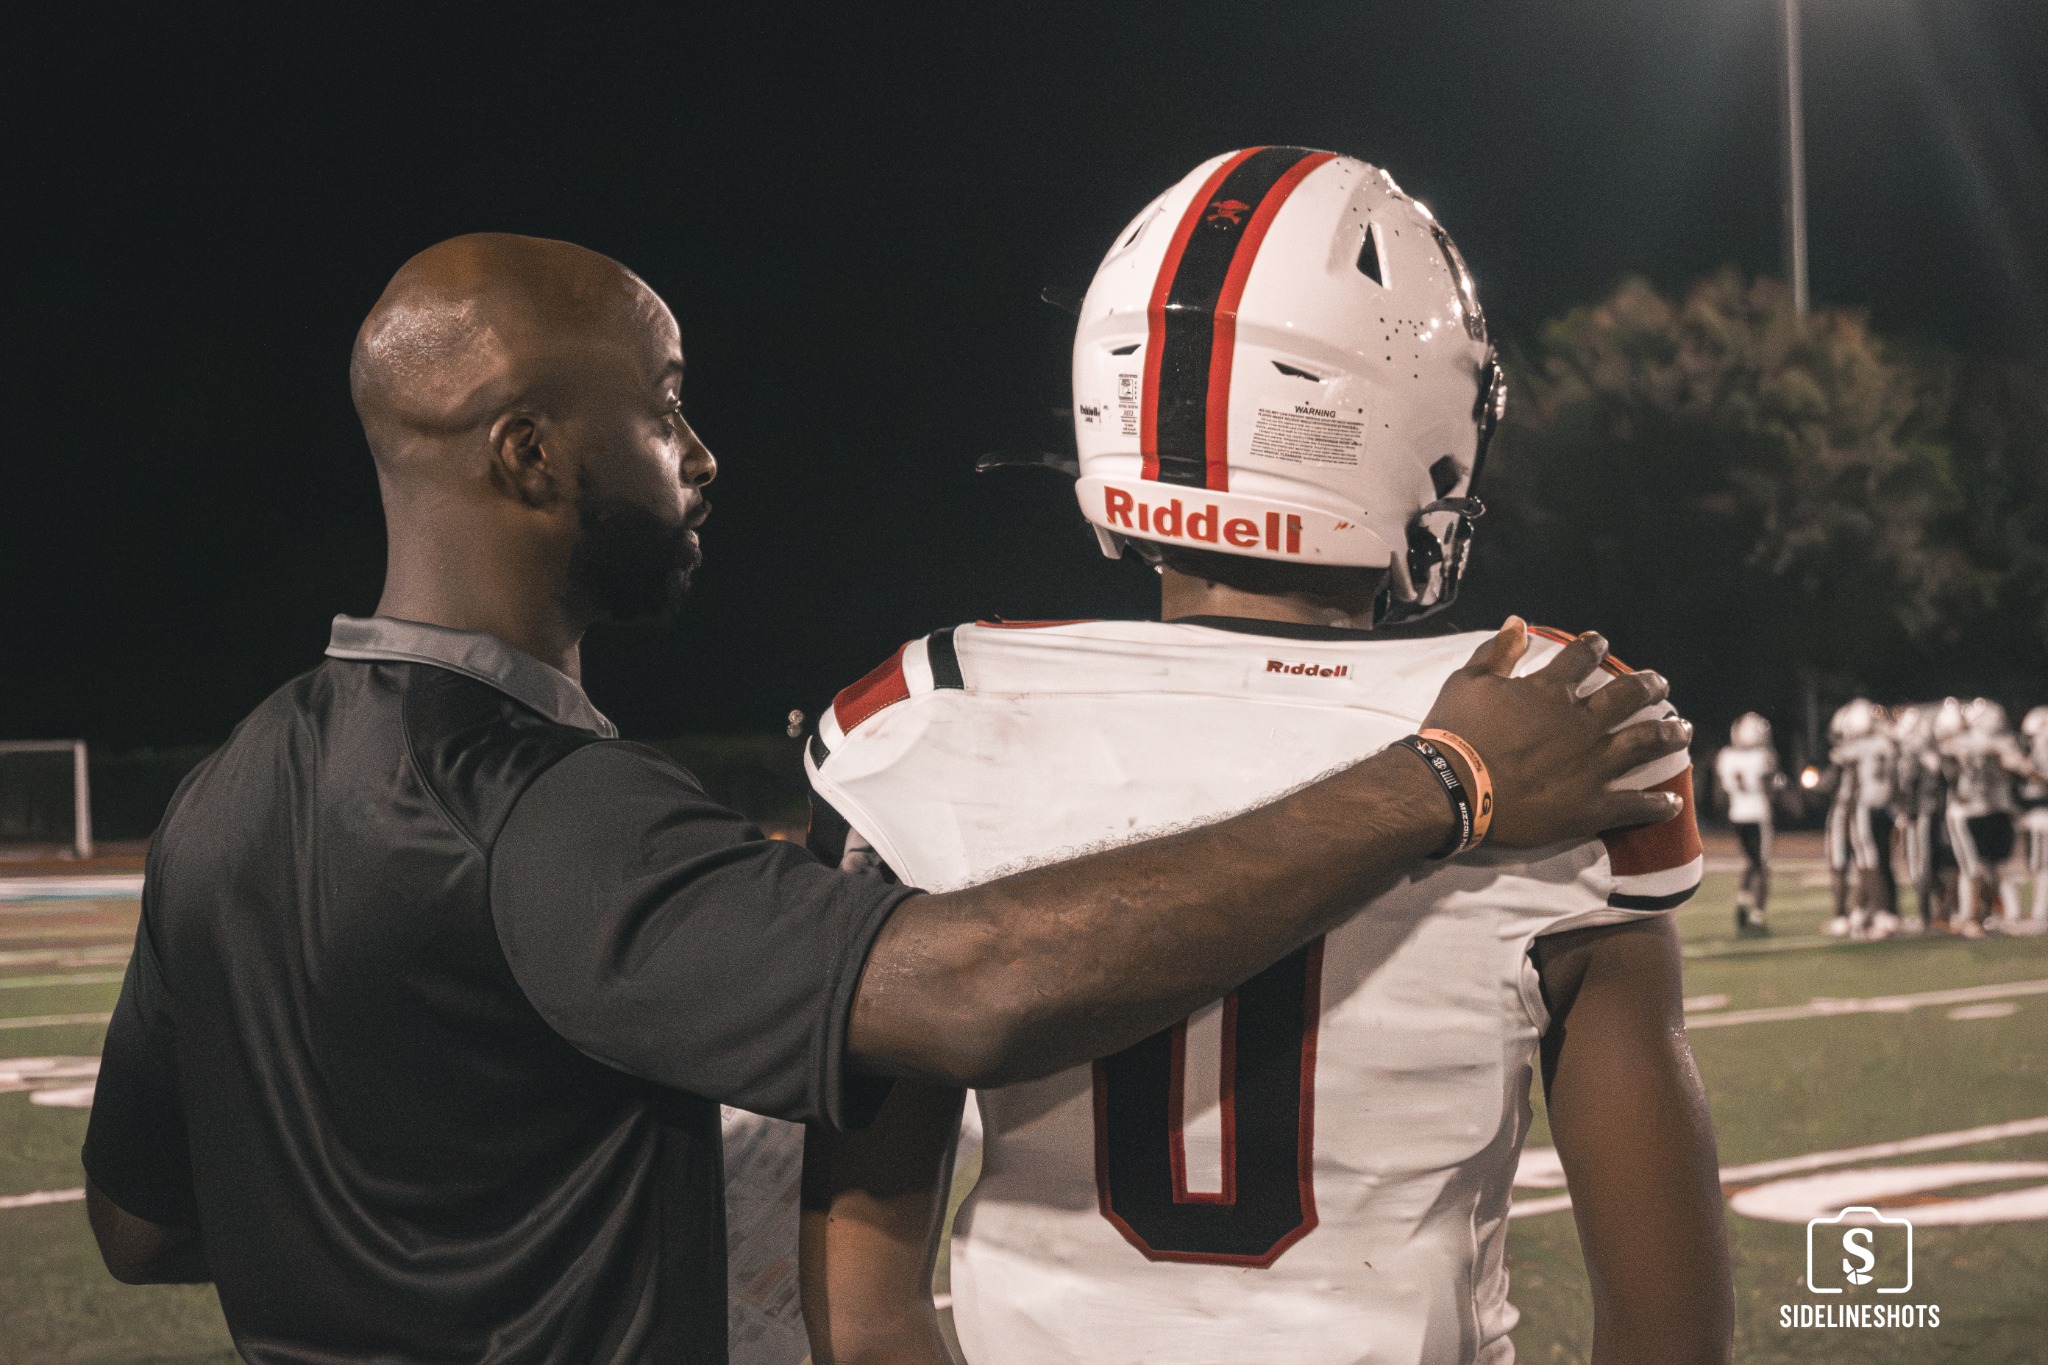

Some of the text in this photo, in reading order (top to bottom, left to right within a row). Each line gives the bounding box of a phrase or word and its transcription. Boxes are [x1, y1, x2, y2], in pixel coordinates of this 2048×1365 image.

[1294, 405, 1337, 419] WARNING
[1103, 486, 1301, 554] Riddell
[1265, 659, 1348, 678] Riddell
